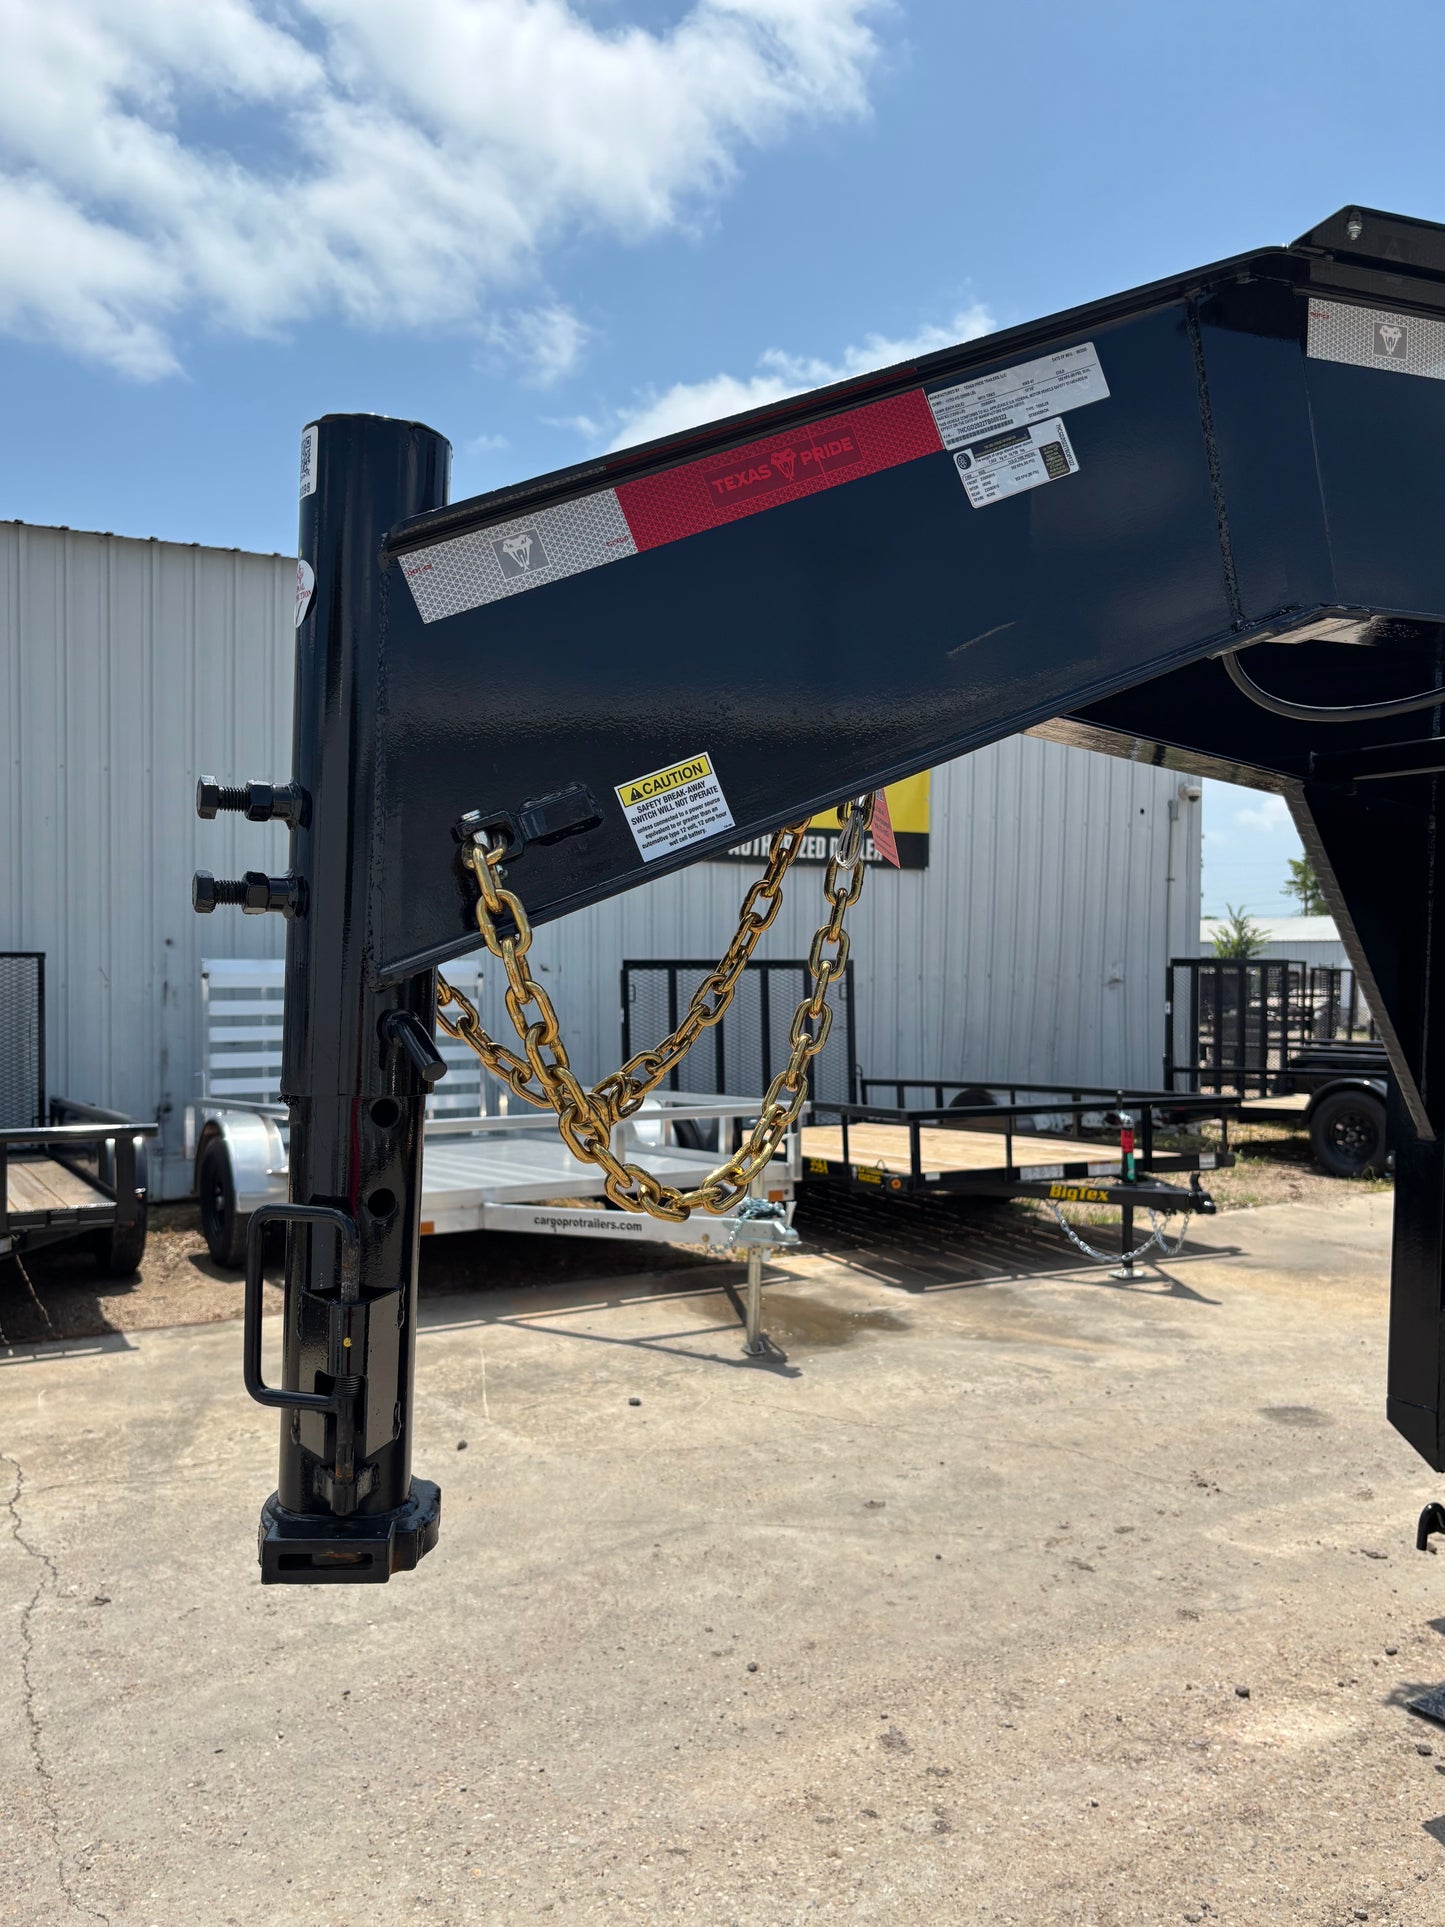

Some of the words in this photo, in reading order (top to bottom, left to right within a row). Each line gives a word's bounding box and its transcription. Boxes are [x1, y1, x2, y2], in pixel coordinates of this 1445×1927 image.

[711, 463, 772, 495] TEXAS
[799, 436, 854, 466] PRIDE
[641, 762, 704, 795] CAUTION
[631, 809, 658, 826] SWITCH
[657, 803, 675, 815] WILL
[674, 797, 689, 808] NOT
[689, 786, 719, 803] OPERATE
[636, 798, 663, 814] SAFETY
[662, 781, 706, 804] BREAK-AWAY
[637, 824, 653, 834] unless
[653, 814, 679, 827] connected
[689, 804, 704, 814] power
[704, 798, 721, 807] source
[642, 835, 669, 849] automotive
[669, 830, 680, 838] type
[687, 823, 698, 831] volt,
[705, 816, 716, 824] amp
[716, 811, 727, 819] hour
[645, 825, 671, 840] equivalent
[682, 814, 700, 825] greater
[700, 809, 712, 818] than
[669, 839, 679, 847] wet
[679, 835, 688, 843] cell
[688, 828, 707, 839] battery.
[1050, 1183, 1109, 1202] BigTex
[534, 1216, 643, 1232] cargoprotrailers.com
